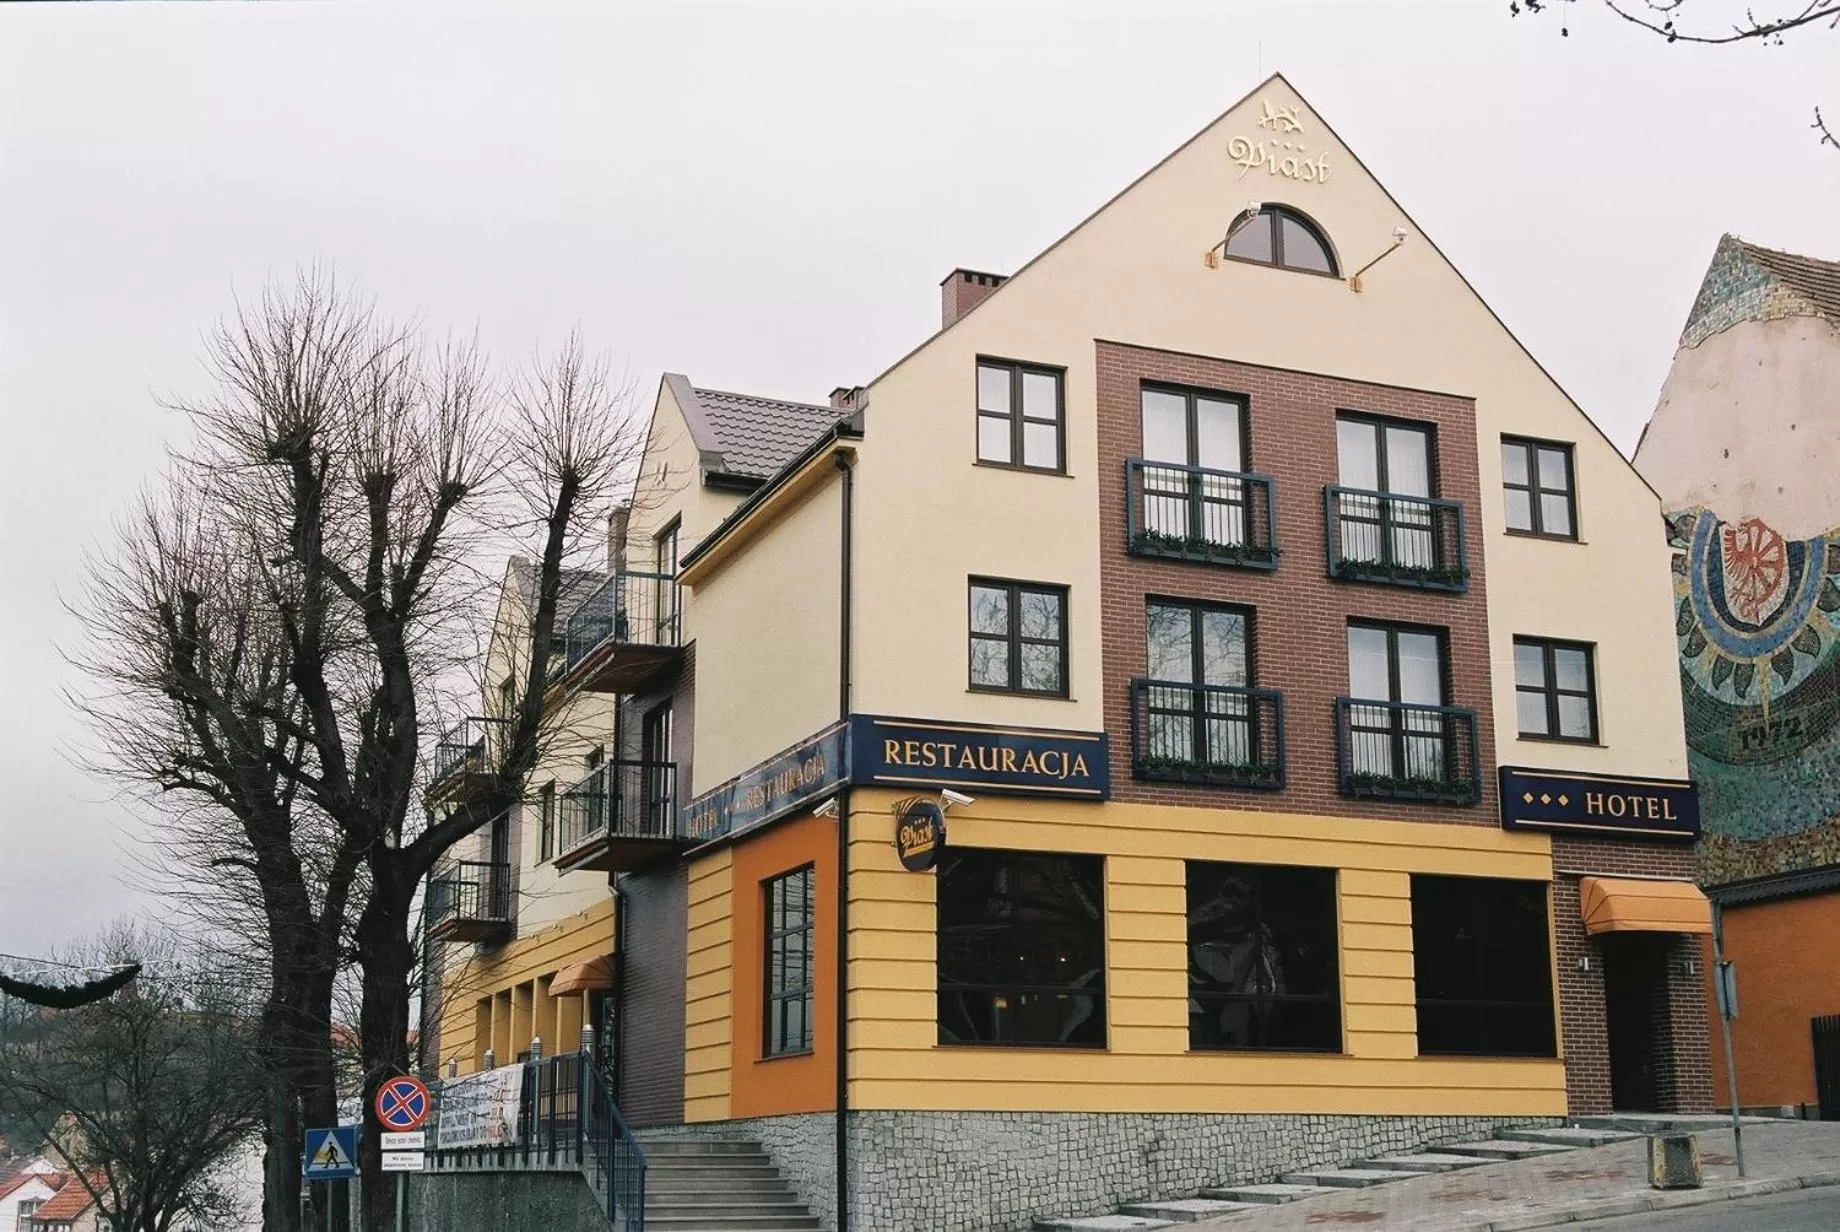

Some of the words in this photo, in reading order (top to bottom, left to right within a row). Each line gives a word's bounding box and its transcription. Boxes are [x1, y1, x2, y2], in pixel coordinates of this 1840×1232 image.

[1227, 136, 1332, 184] Piast
[884, 739, 1090, 780] RESTAURACJA
[746, 754, 824, 811] RESTAURACJA
[1586, 792, 1677, 820] HOTEL
[900, 816, 933, 850] Piast
